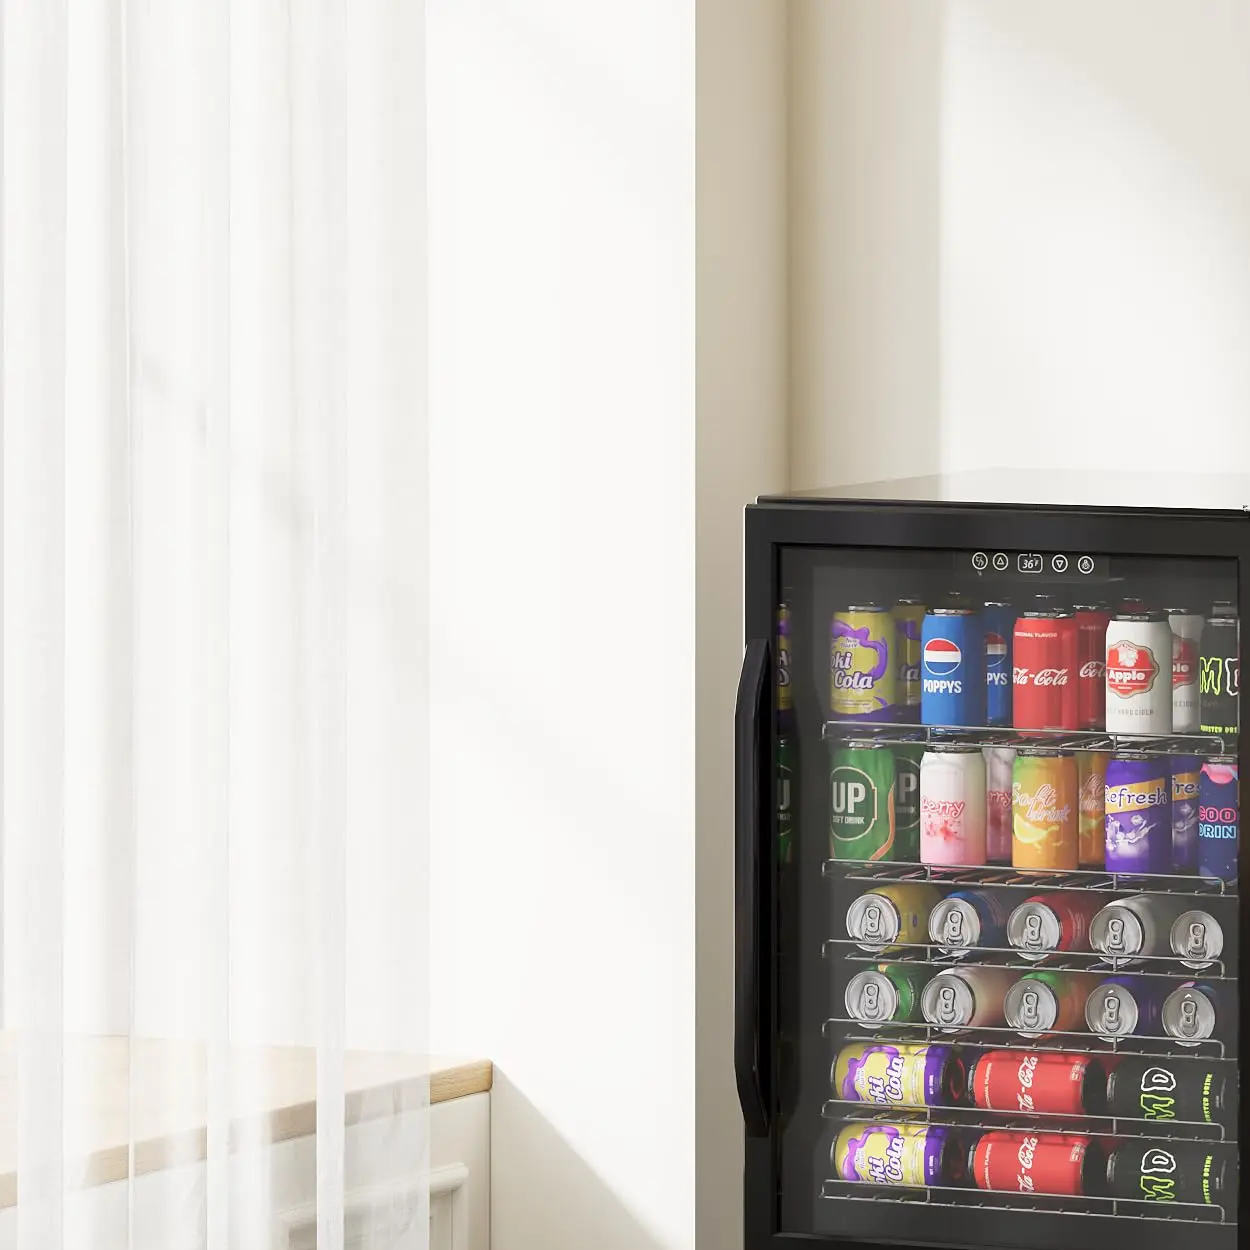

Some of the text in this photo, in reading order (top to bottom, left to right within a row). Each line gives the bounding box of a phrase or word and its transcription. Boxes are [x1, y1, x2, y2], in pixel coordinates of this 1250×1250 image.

[834, 671, 874, 690] Cola
[987, 672, 1008, 686] PYS
[1108, 669, 1145, 683] Apple
[924, 679, 962, 694] POPPYS
[832, 782, 866, 813] UP
[989, 790, 1011, 806] rry
[886, 1056, 904, 1101] Cola
[886, 1136, 904, 1181] Cola
